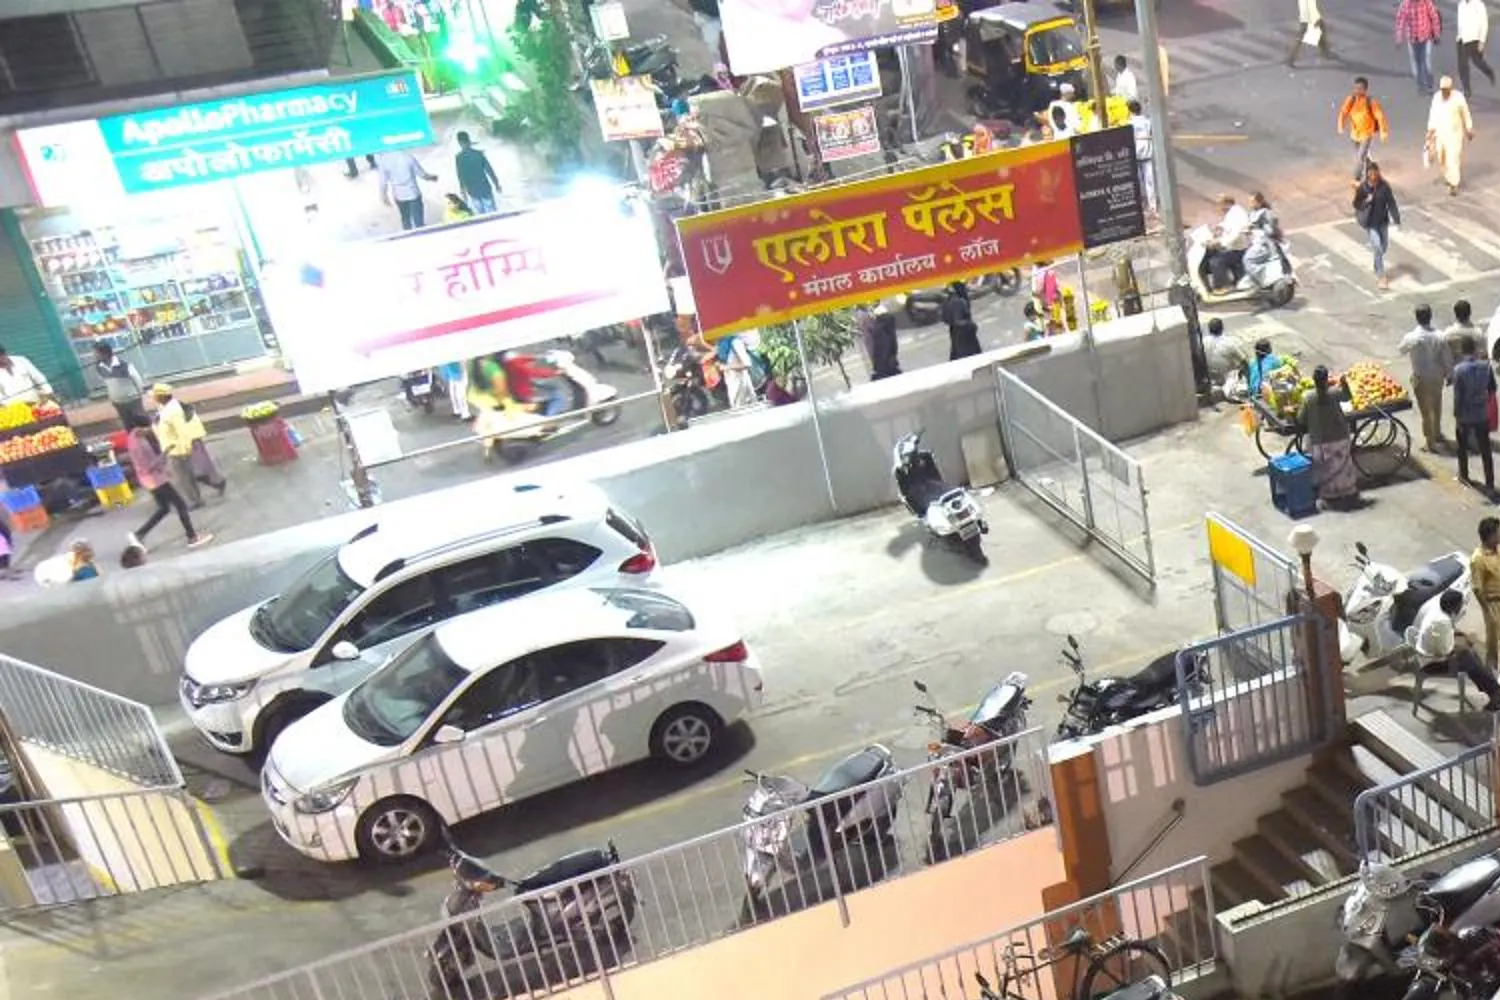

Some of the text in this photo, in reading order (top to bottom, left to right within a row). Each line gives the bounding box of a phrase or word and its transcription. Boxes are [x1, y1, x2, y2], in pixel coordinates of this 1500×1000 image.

[752, 180, 1016, 283] एलोरा पॅलेस
[802, 238, 1000, 297] मंगल कार्यालय लॉज
